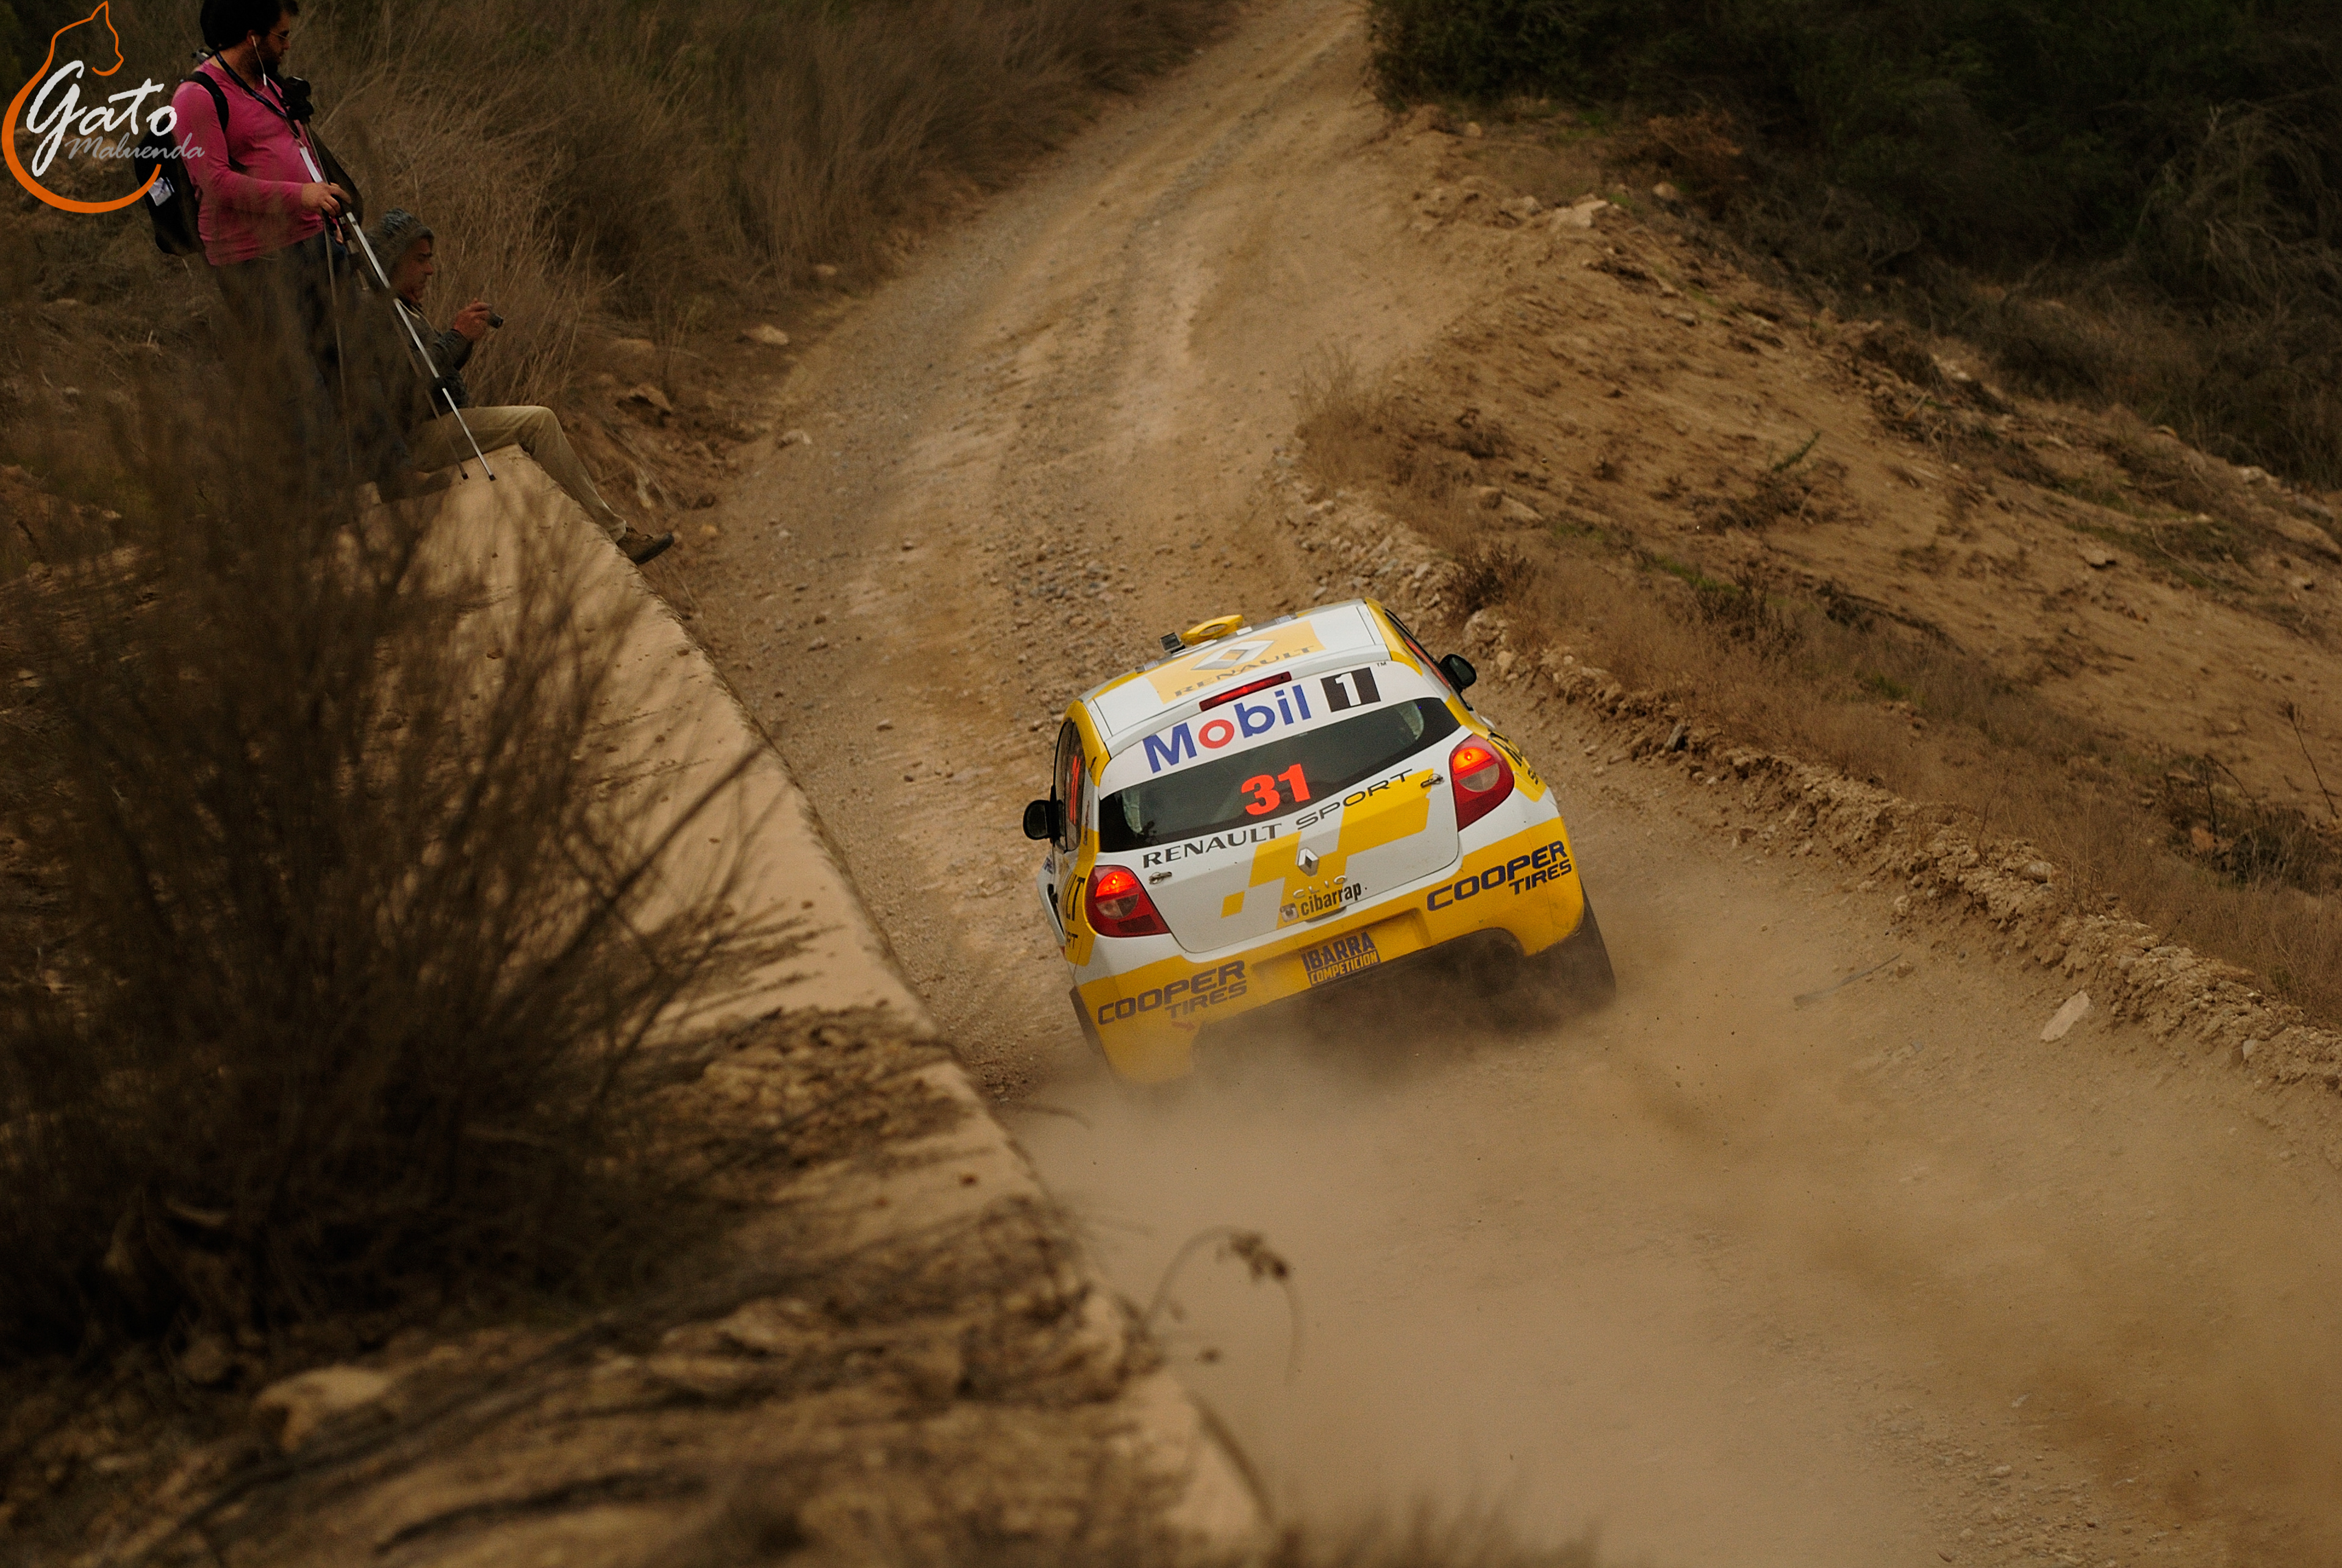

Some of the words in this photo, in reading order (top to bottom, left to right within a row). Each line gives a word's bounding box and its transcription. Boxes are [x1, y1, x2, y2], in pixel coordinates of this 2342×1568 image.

[1175, 646, 1316, 697] RENAULT
[1142, 684, 1311, 774] Mobil
[1334, 672, 1361, 706] 1
[1241, 764, 1311, 816] 31
[1143, 823, 1282, 868] RENAULT
[1295, 768, 1413, 830] SPORT
[1293, 875, 1347, 899] CLIO
[1427, 840, 1567, 911] COOPER
[1508, 859, 1572, 895] TIRES
[1300, 882, 1361, 916] cibarrap
[1301, 932, 1375, 972] IBARRA
[1311, 951, 1378, 984] COMPETICION
[1098, 960, 1246, 1025] COOPER
[1164, 979, 1247, 1018] TIRES
